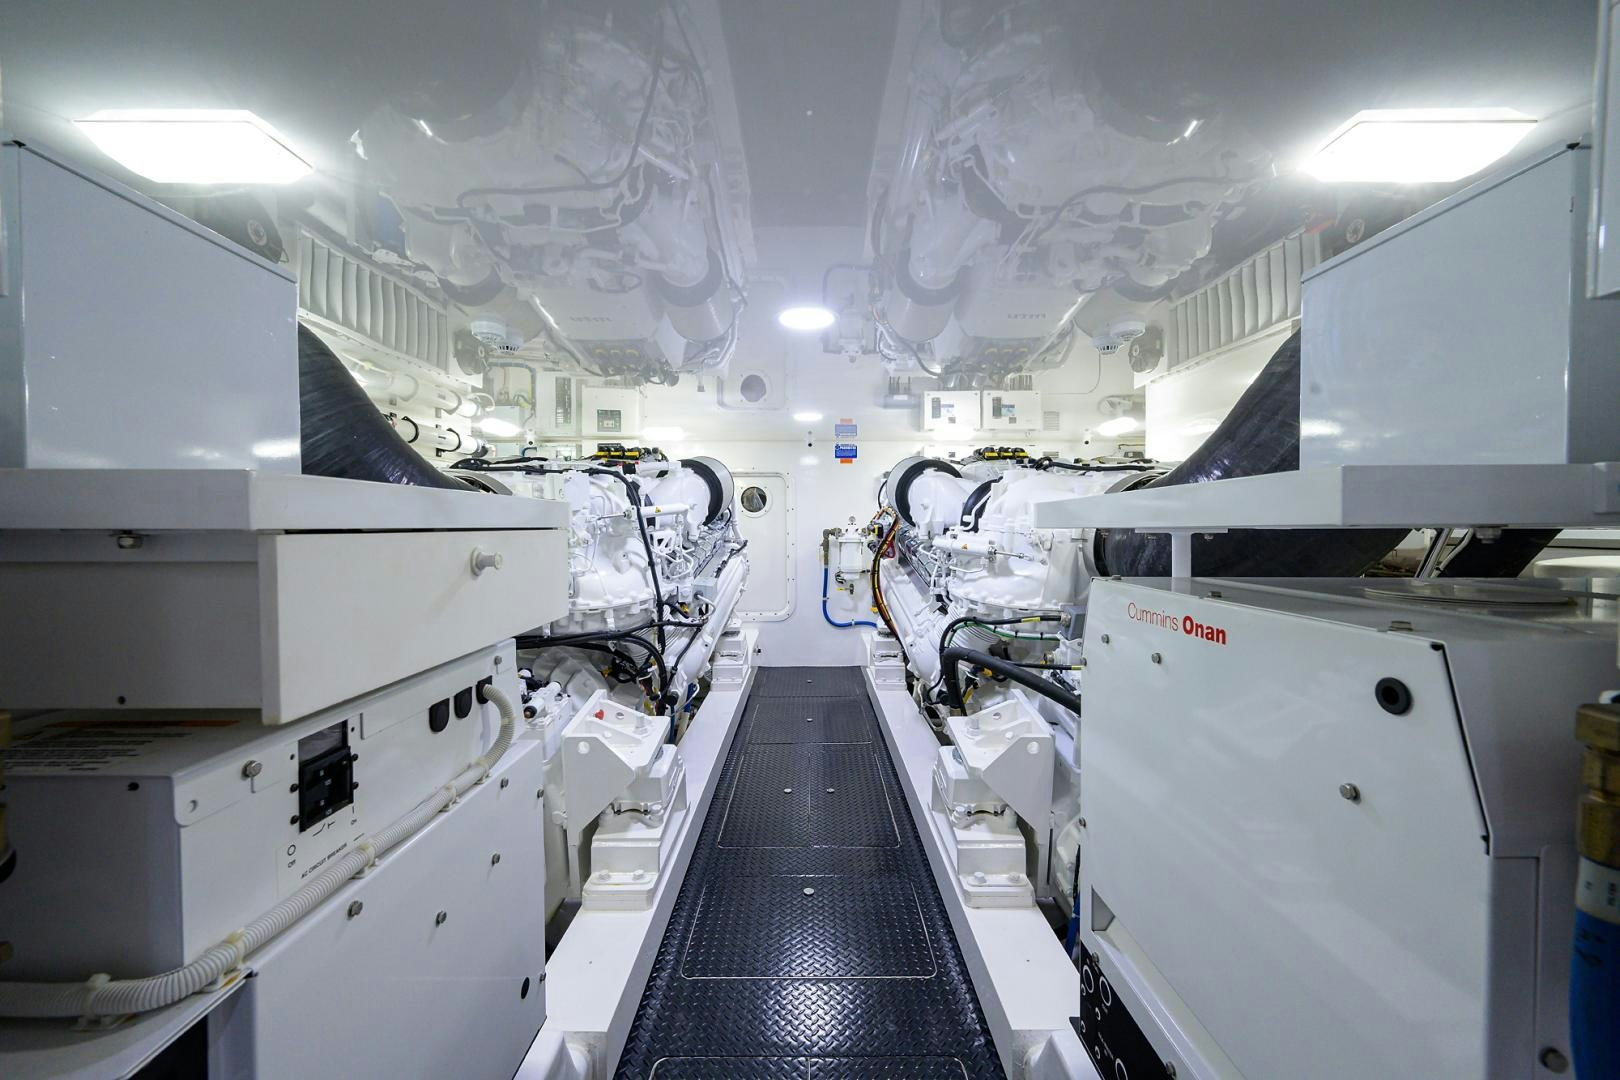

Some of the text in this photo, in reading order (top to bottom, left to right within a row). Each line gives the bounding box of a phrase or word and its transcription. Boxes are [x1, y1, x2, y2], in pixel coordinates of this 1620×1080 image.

[1128, 602, 1227, 645] Cummins Onan
[308, 857, 326, 873] CIRCUIT
[327, 842, 347, 860] BREAKER
